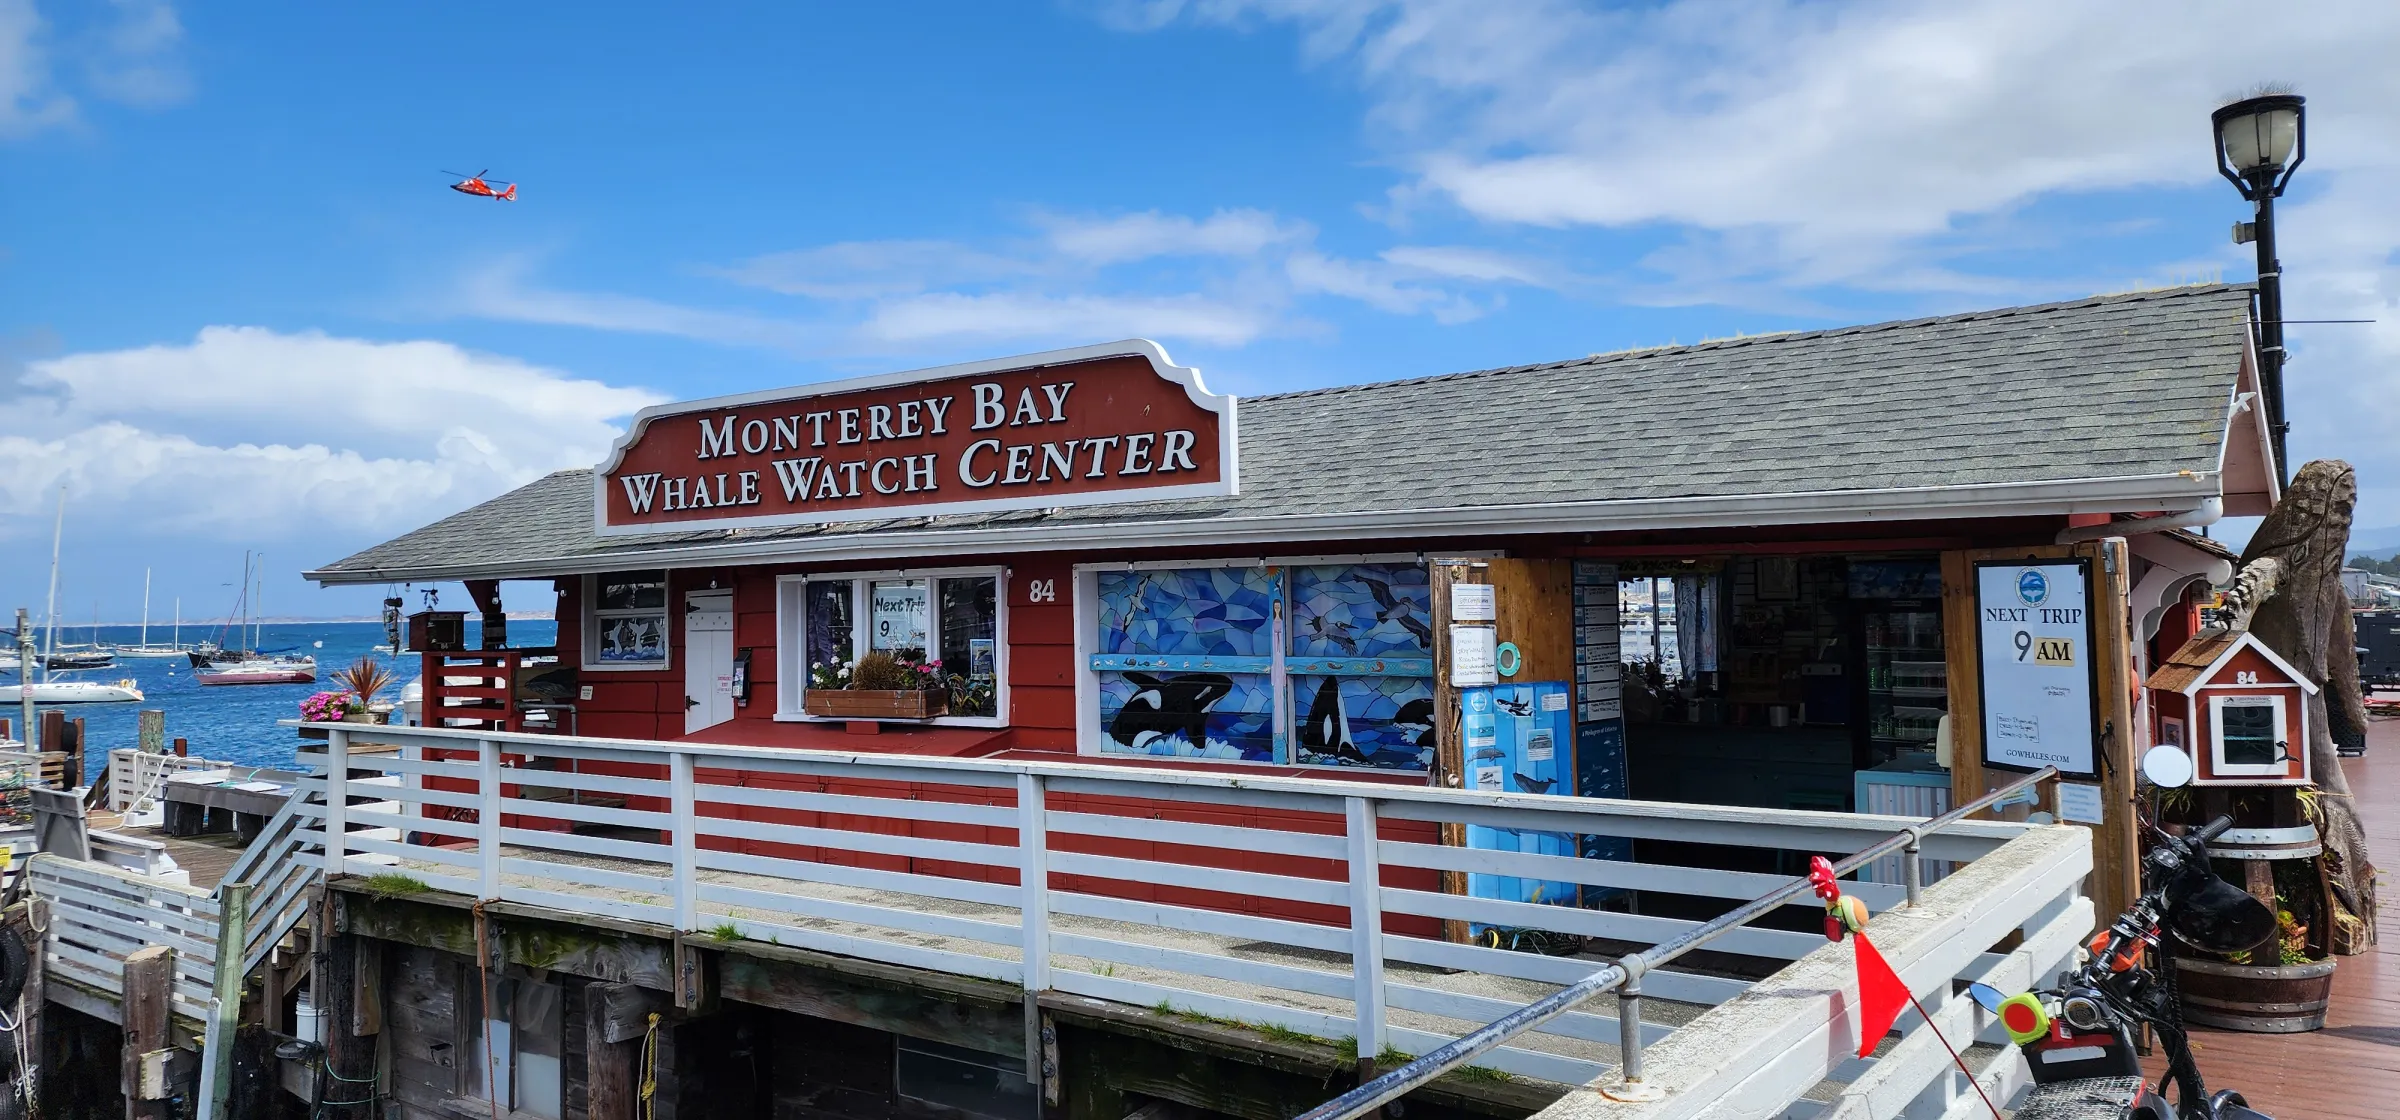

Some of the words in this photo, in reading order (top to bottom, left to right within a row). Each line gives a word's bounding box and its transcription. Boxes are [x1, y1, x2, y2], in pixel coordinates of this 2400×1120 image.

[697, 396, 954, 460] MONTEREY
[971, 382, 1075, 431] BAY
[619, 470, 762, 515] WHALE
[772, 453, 938, 502] WATCH
[958, 429, 1198, 488] CENTER
[1029, 578, 1055, 603] 84
[874, 597, 904, 613] Next
[1986, 608, 2028, 622] NEXT
[2040, 608, 2082, 624] TRIP
[880, 620, 890, 637] 9
[2014, 630, 2032, 662] 9
[2036, 641, 2072, 662] AM
[2237, 671, 2258, 684] 84
[2006, 749, 2070, 763] GOWHALES.COM
